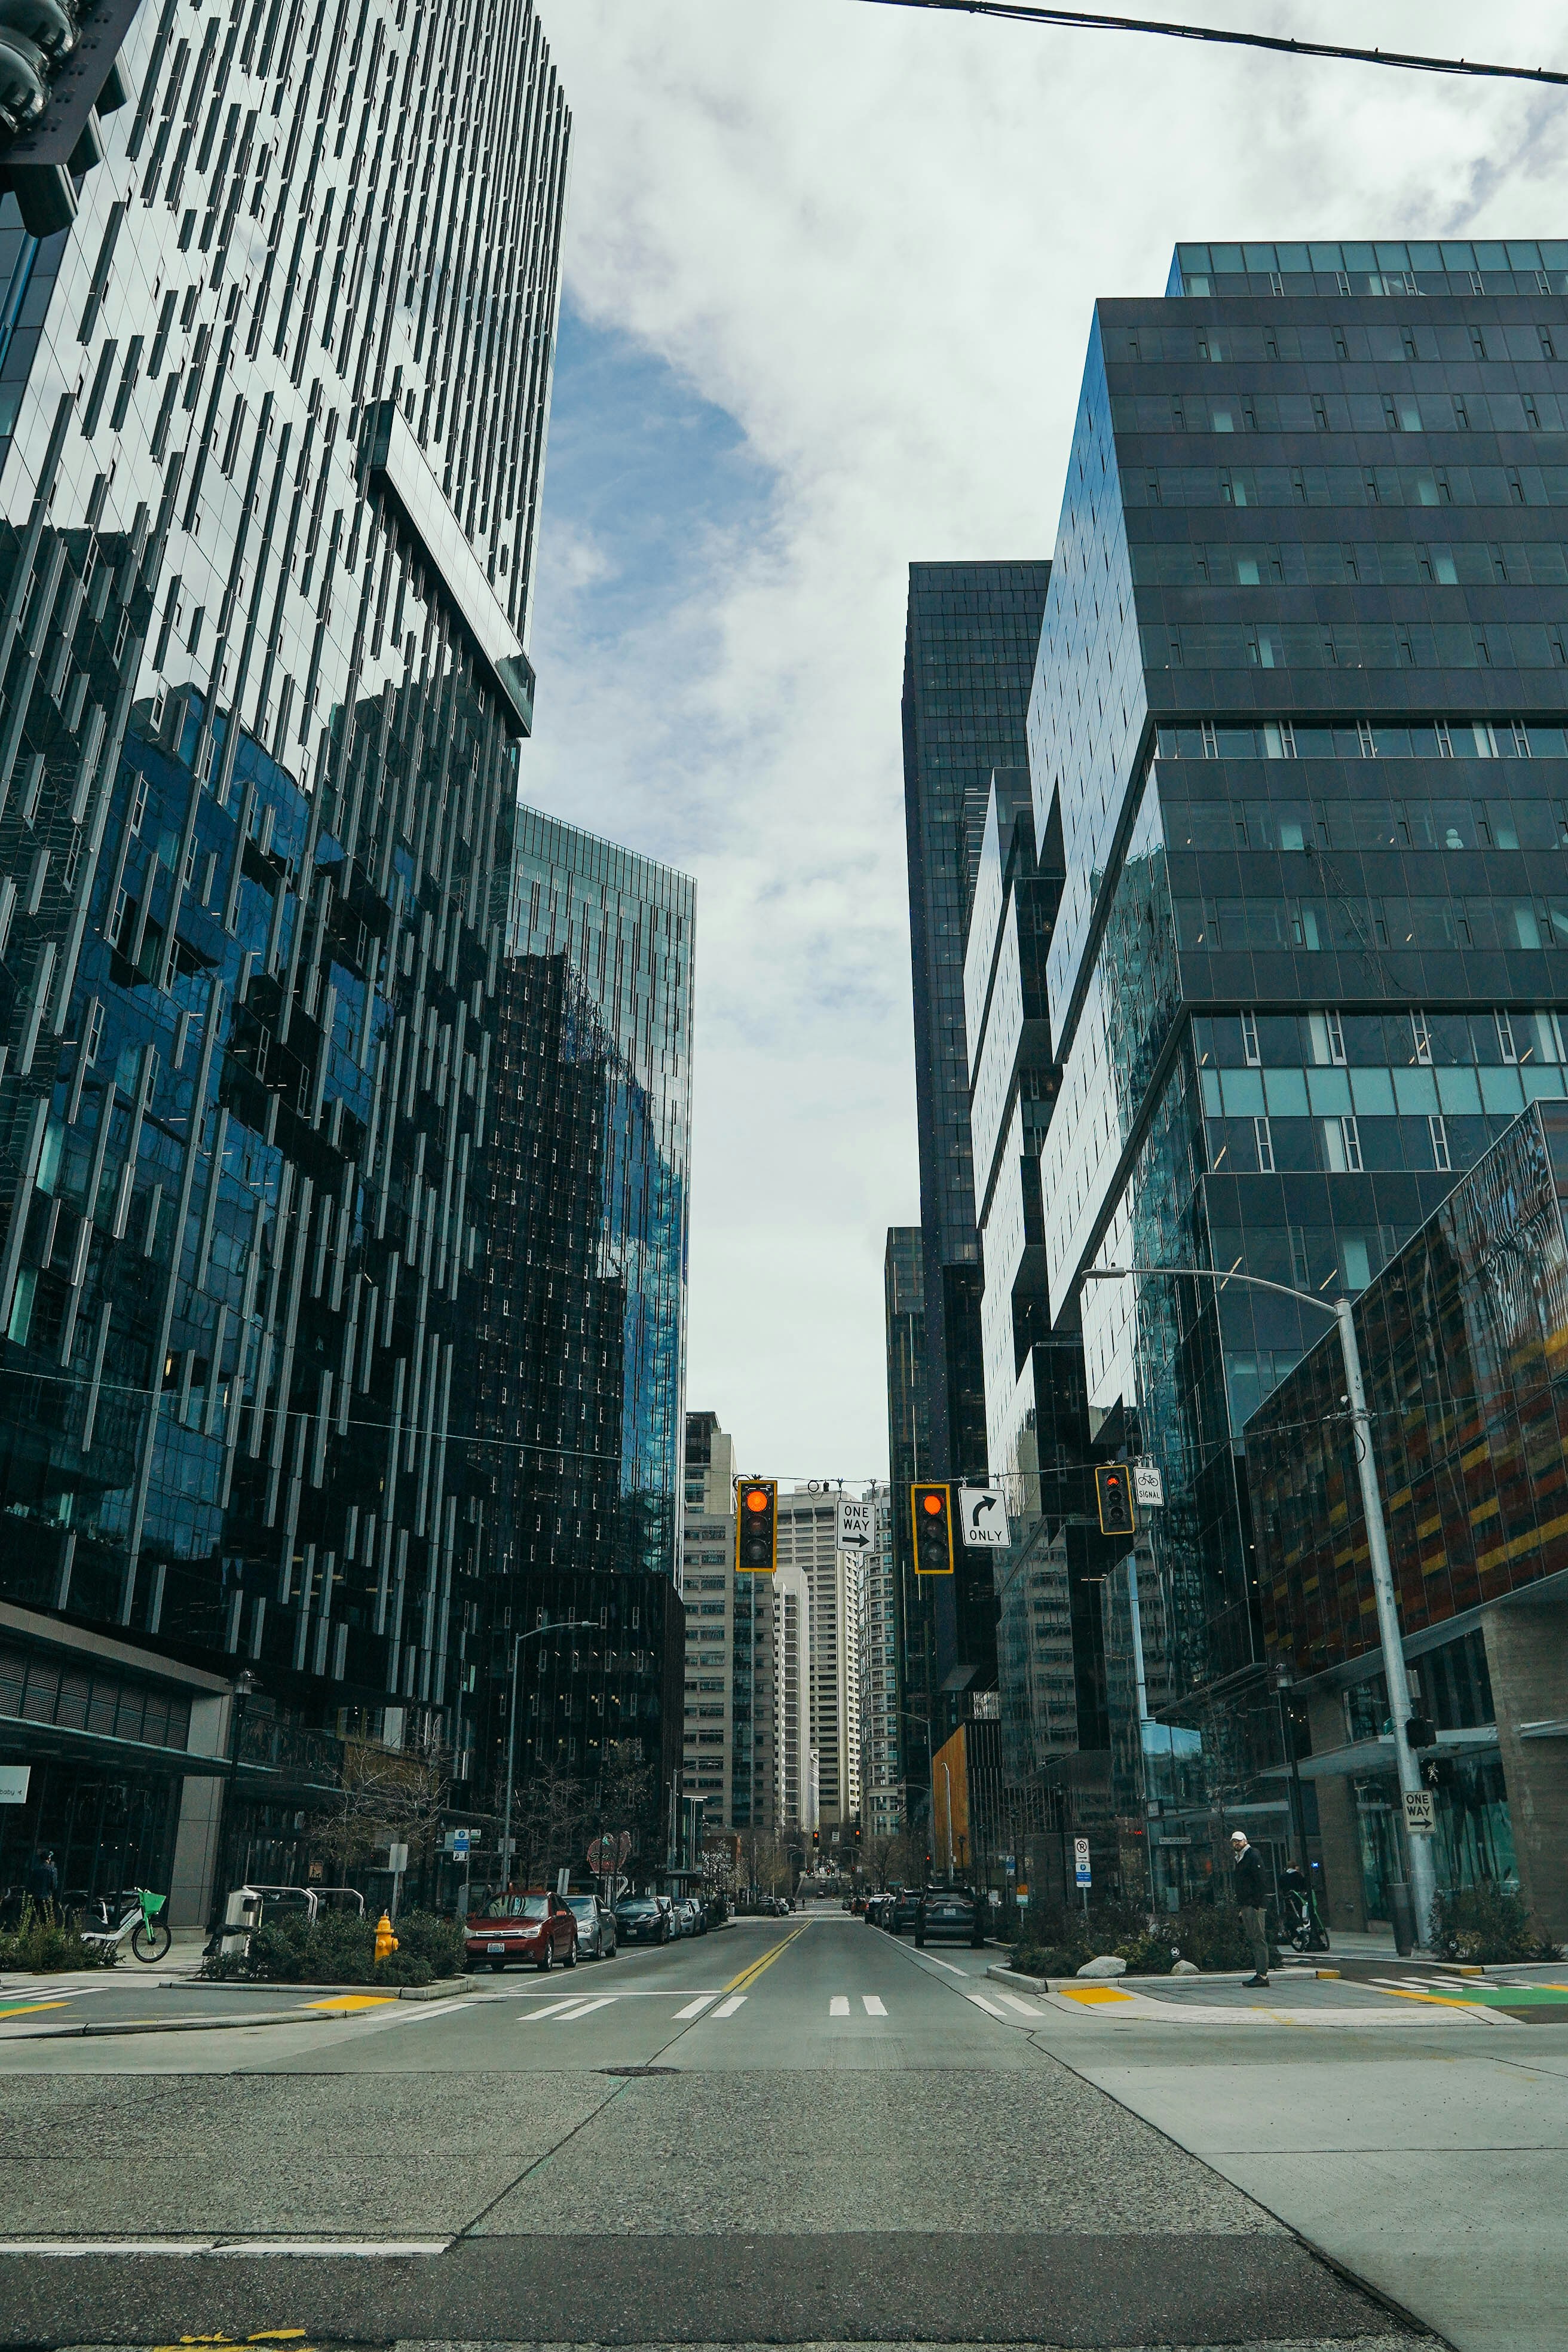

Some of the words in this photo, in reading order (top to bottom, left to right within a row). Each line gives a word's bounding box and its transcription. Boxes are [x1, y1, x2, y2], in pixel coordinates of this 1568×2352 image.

[1139, 1490, 1160, 1499] SIGNAL
[844, 1505, 869, 1518] ONE
[843, 1518, 870, 1531] WAY
[969, 1530, 1002, 1541] ONLY
[1406, 1794, 1429, 1804] ONE
[1407, 1806, 1430, 1816] WAY
